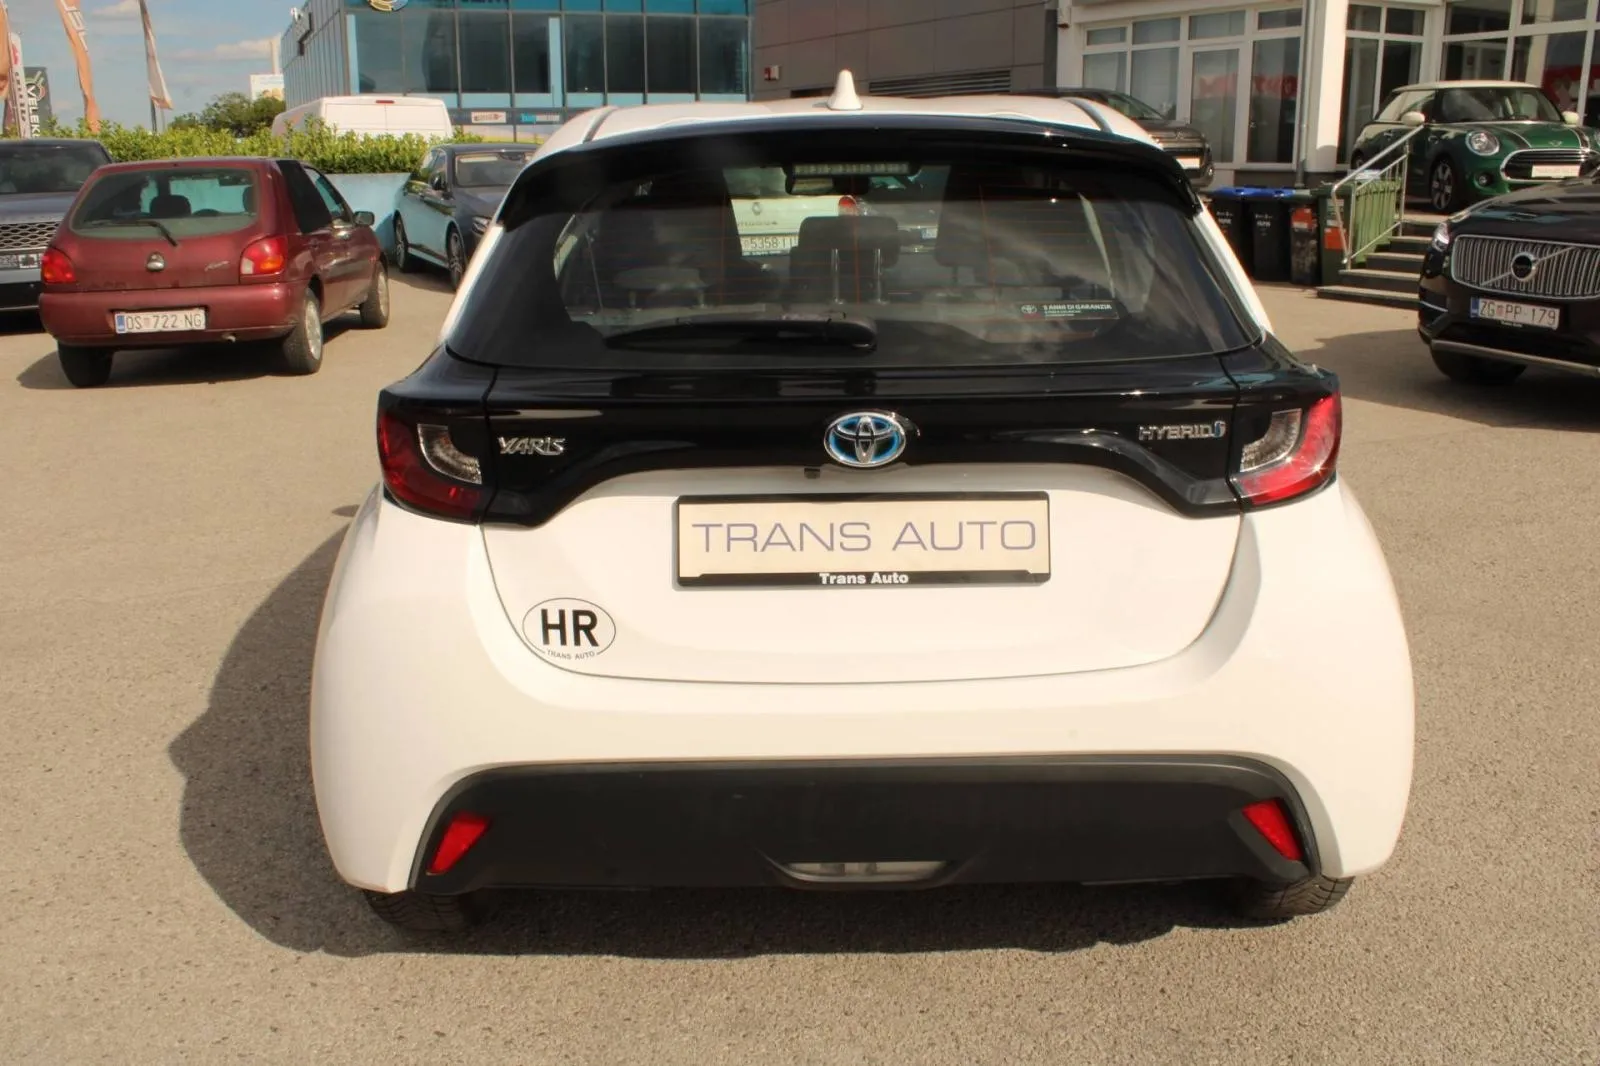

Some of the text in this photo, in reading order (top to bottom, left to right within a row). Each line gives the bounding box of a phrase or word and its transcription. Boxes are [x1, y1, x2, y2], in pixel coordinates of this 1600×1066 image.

[1138, 424, 1212, 440] HYBRID
[498, 436, 565, 456] YARIS
[692, 520, 1036, 553] TRANS AUTO
[819, 571, 909, 585] Trans Auto
[541, 608, 599, 647] HR
[547, 649, 596, 661] TRANS AUTO
